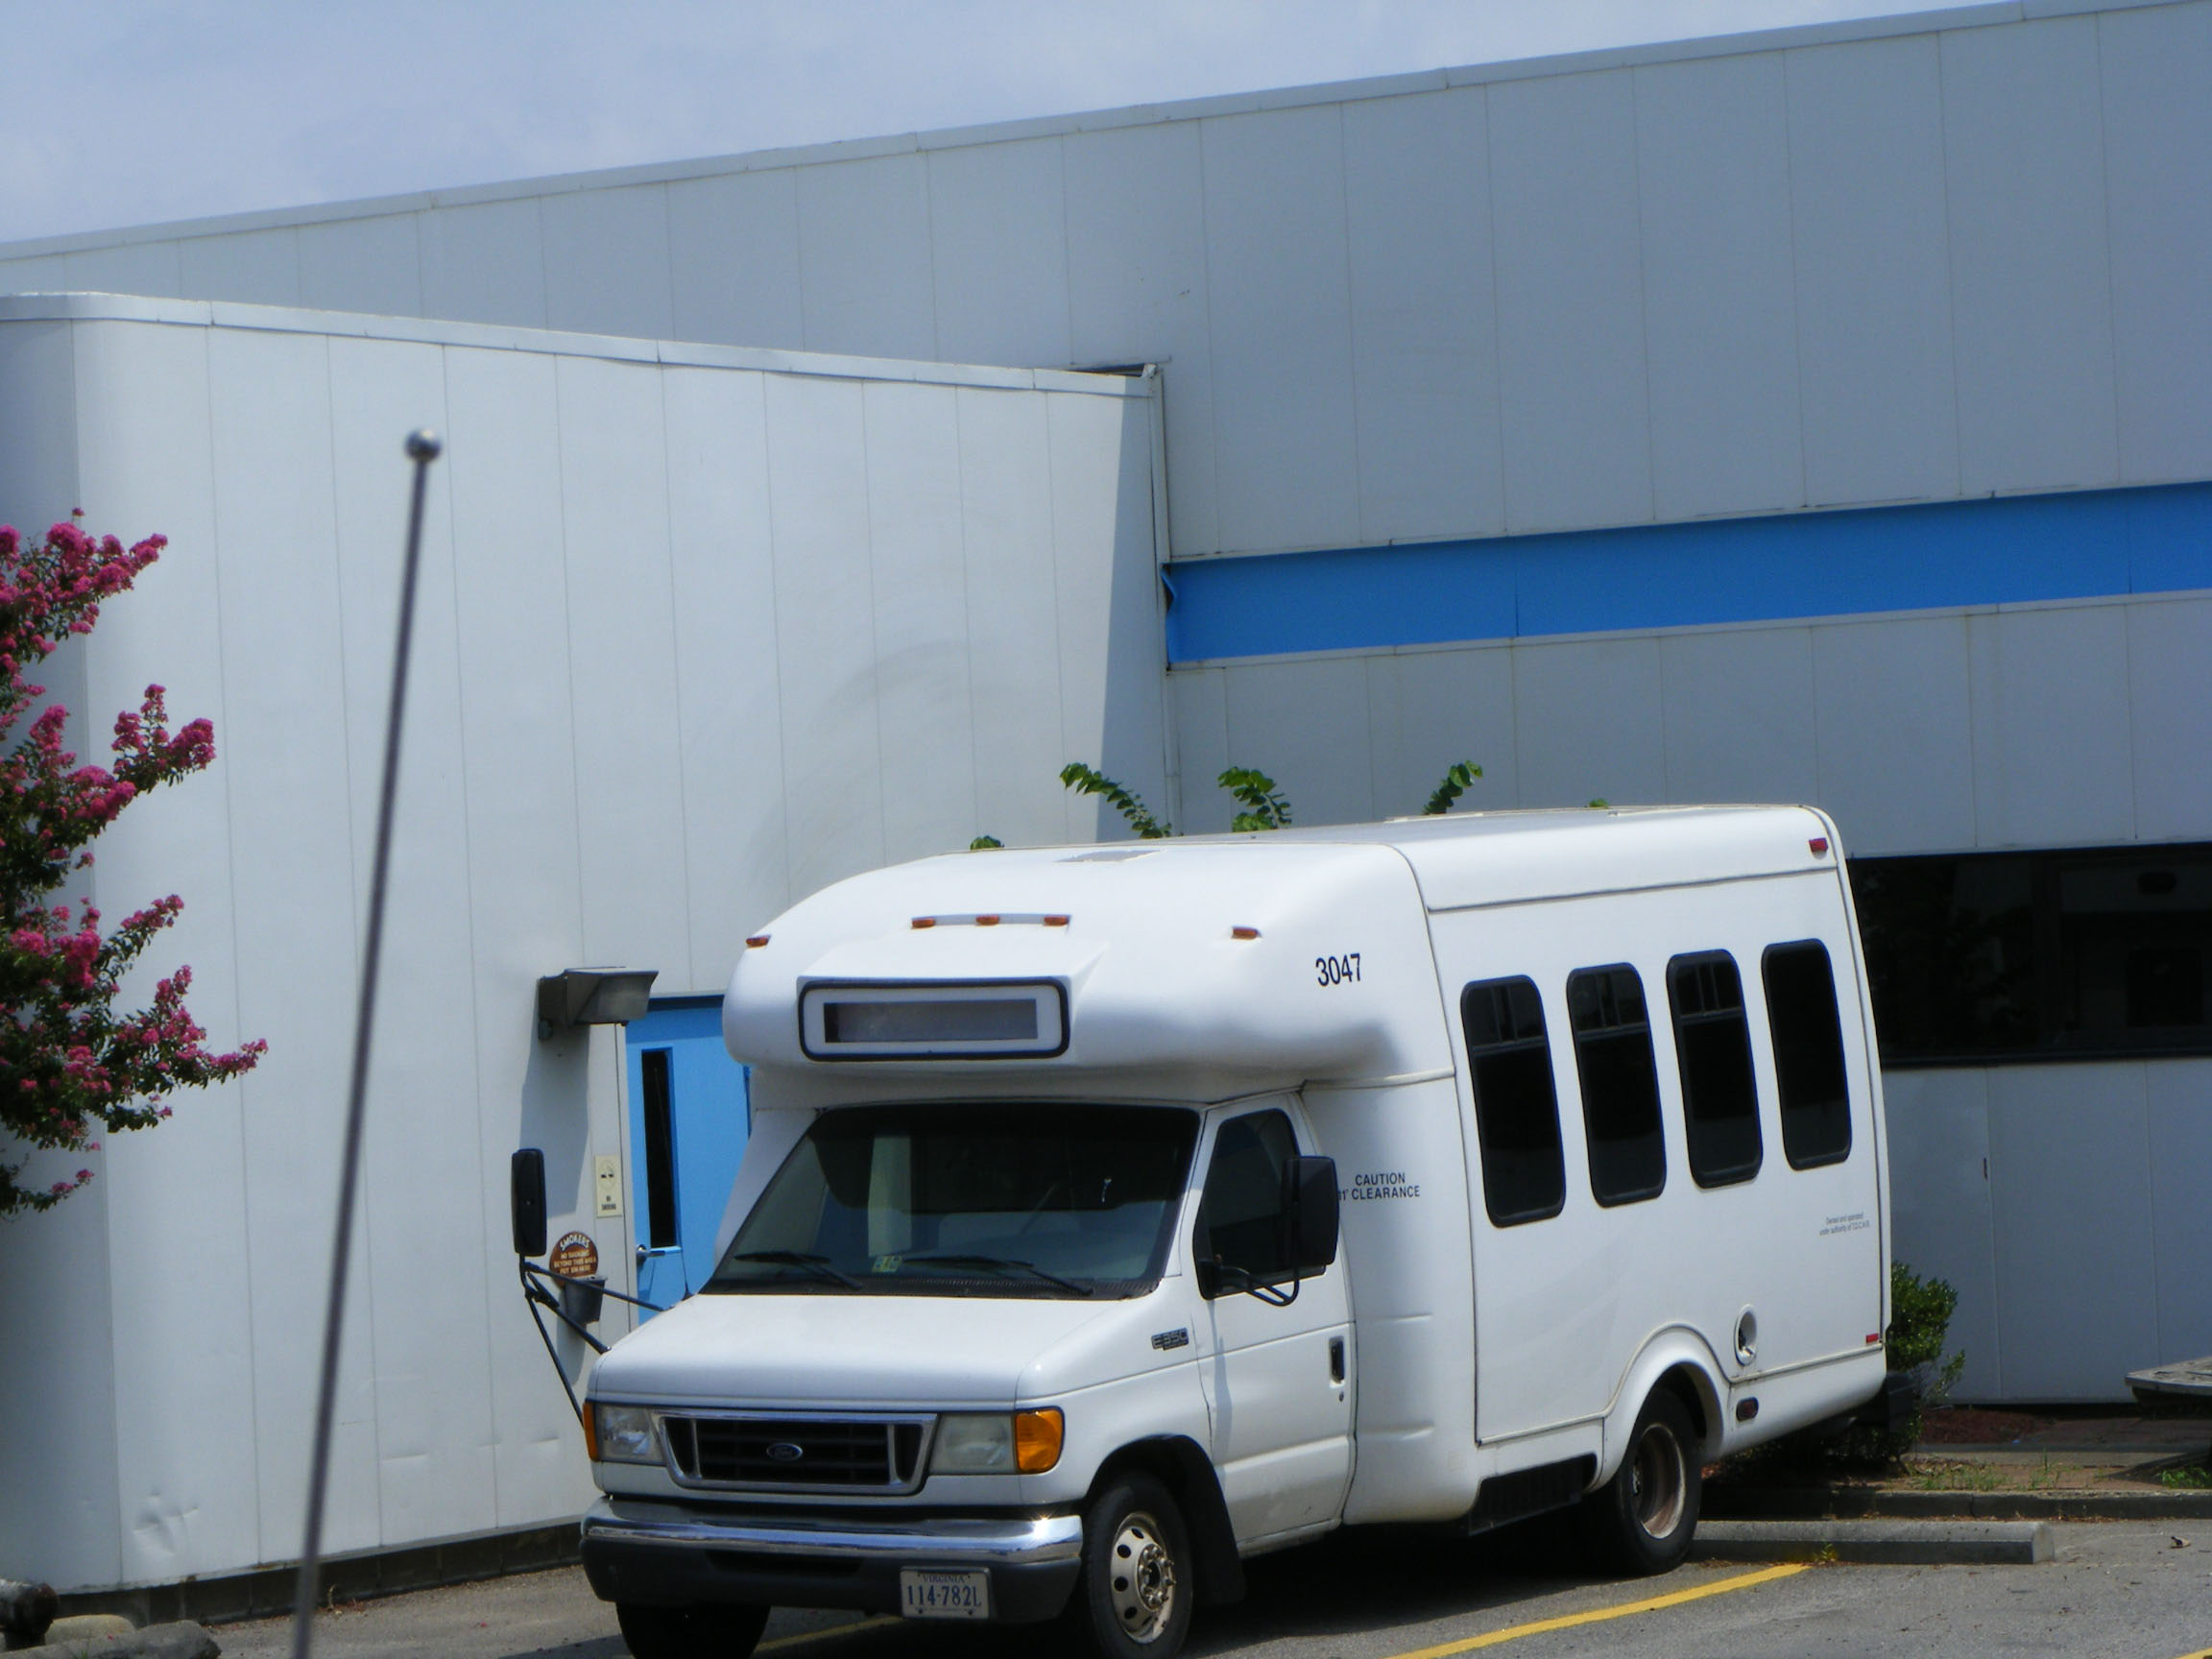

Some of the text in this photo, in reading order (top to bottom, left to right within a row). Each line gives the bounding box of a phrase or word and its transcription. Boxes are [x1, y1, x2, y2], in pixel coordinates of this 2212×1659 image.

[1315, 952, 1361, 987] 3047
[1355, 1172, 1406, 1187] CAUTION
[1351, 1185, 1421, 1200] CLEARANCE
[560, 1234, 590, 1252] SMOKERS
[923, 1574, 966, 1583] VIRGINIA
[907, 1584, 982, 1607] 114-782L
